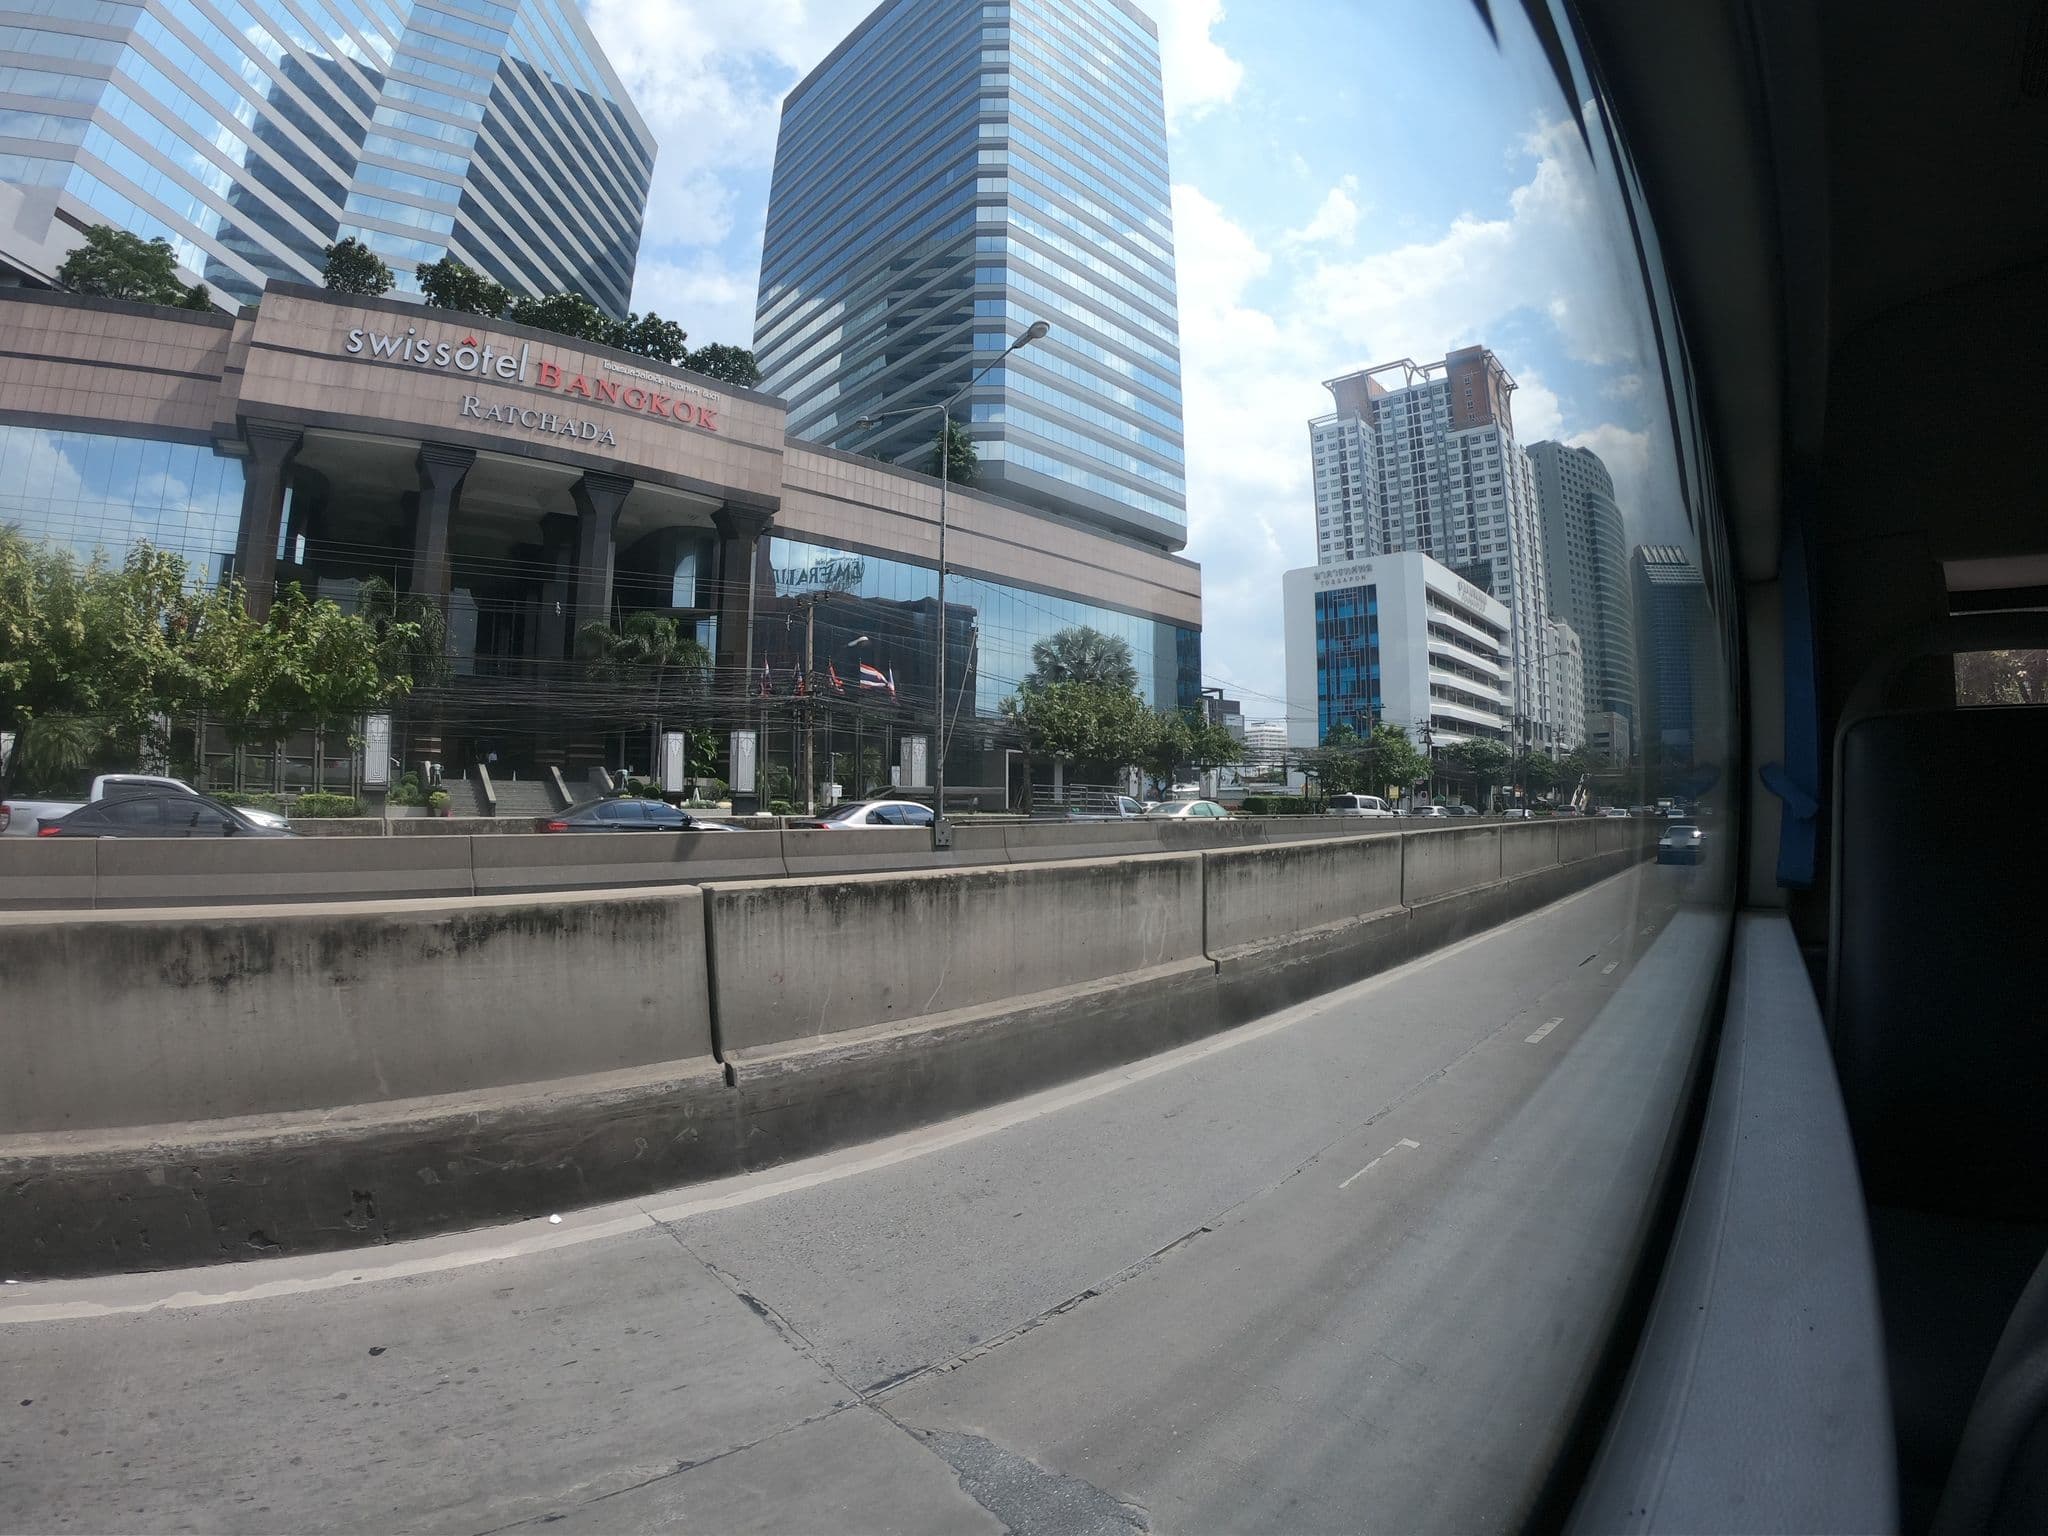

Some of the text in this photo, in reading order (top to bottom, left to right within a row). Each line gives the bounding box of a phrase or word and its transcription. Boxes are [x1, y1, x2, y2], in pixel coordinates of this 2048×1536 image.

[346, 326, 718, 432] swissôtel BANGKOK
[459, 394, 617, 446] RATCHADA
